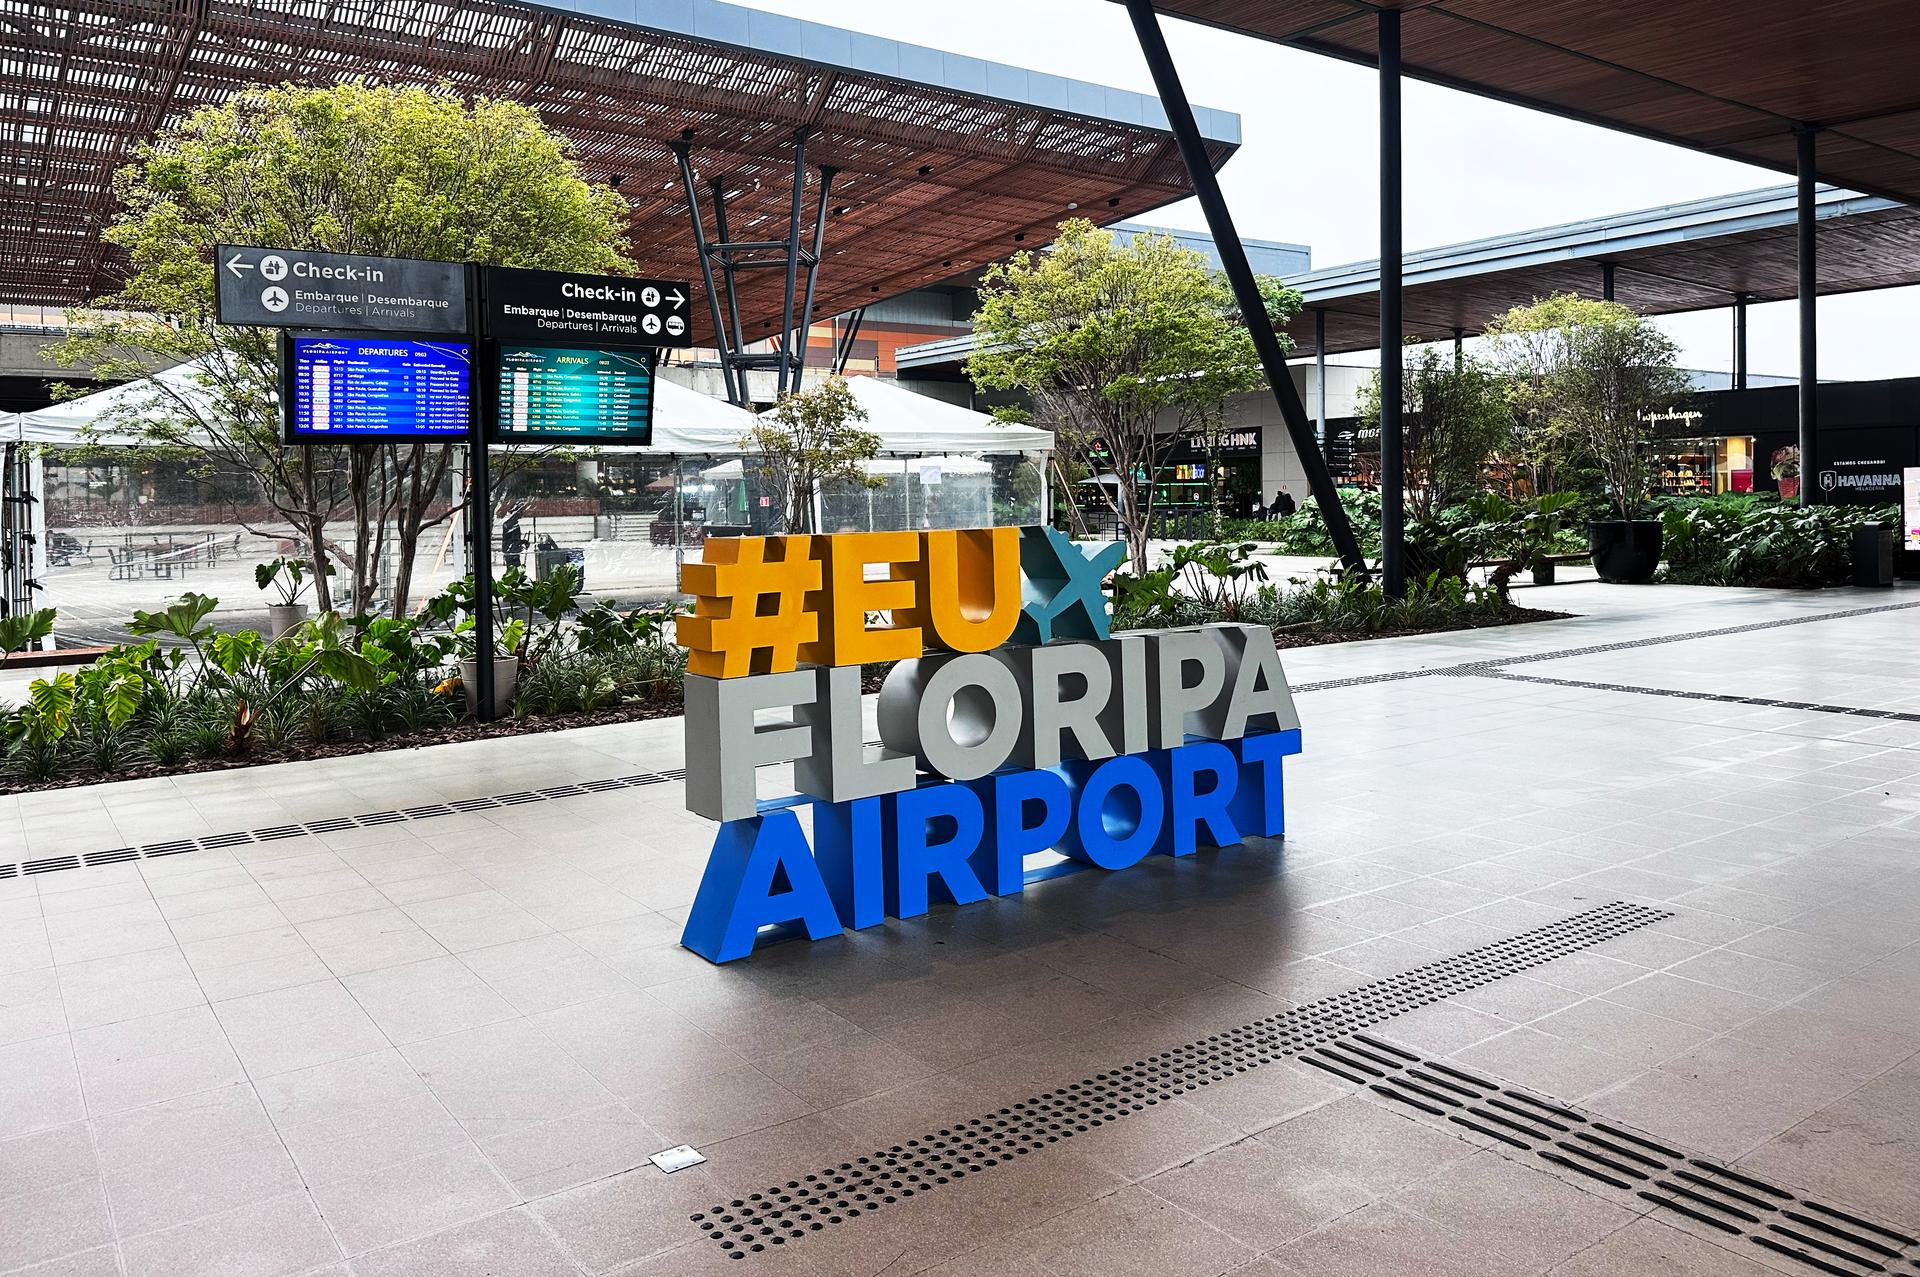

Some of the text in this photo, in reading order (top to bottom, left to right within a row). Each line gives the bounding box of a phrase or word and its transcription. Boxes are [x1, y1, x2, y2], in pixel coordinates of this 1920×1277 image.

[293, 262, 384, 282] Check-in
[295, 290, 449, 309] Embarque Desembarque
[562, 283, 636, 302] Check-in
[296, 303, 415, 318] Departures Arrivals
[504, 305, 637, 322] Embarque Desembarque
[538, 318, 638, 334] Departures Arrivals
[358, 347, 408, 357] DEPARTURES
[1838, 474, 1901, 487] HAVANNA
[676, 526, 1022, 679] #EU
[684, 623, 1301, 822] FLORIPA
[680, 728, 1302, 964] AIRPORT
